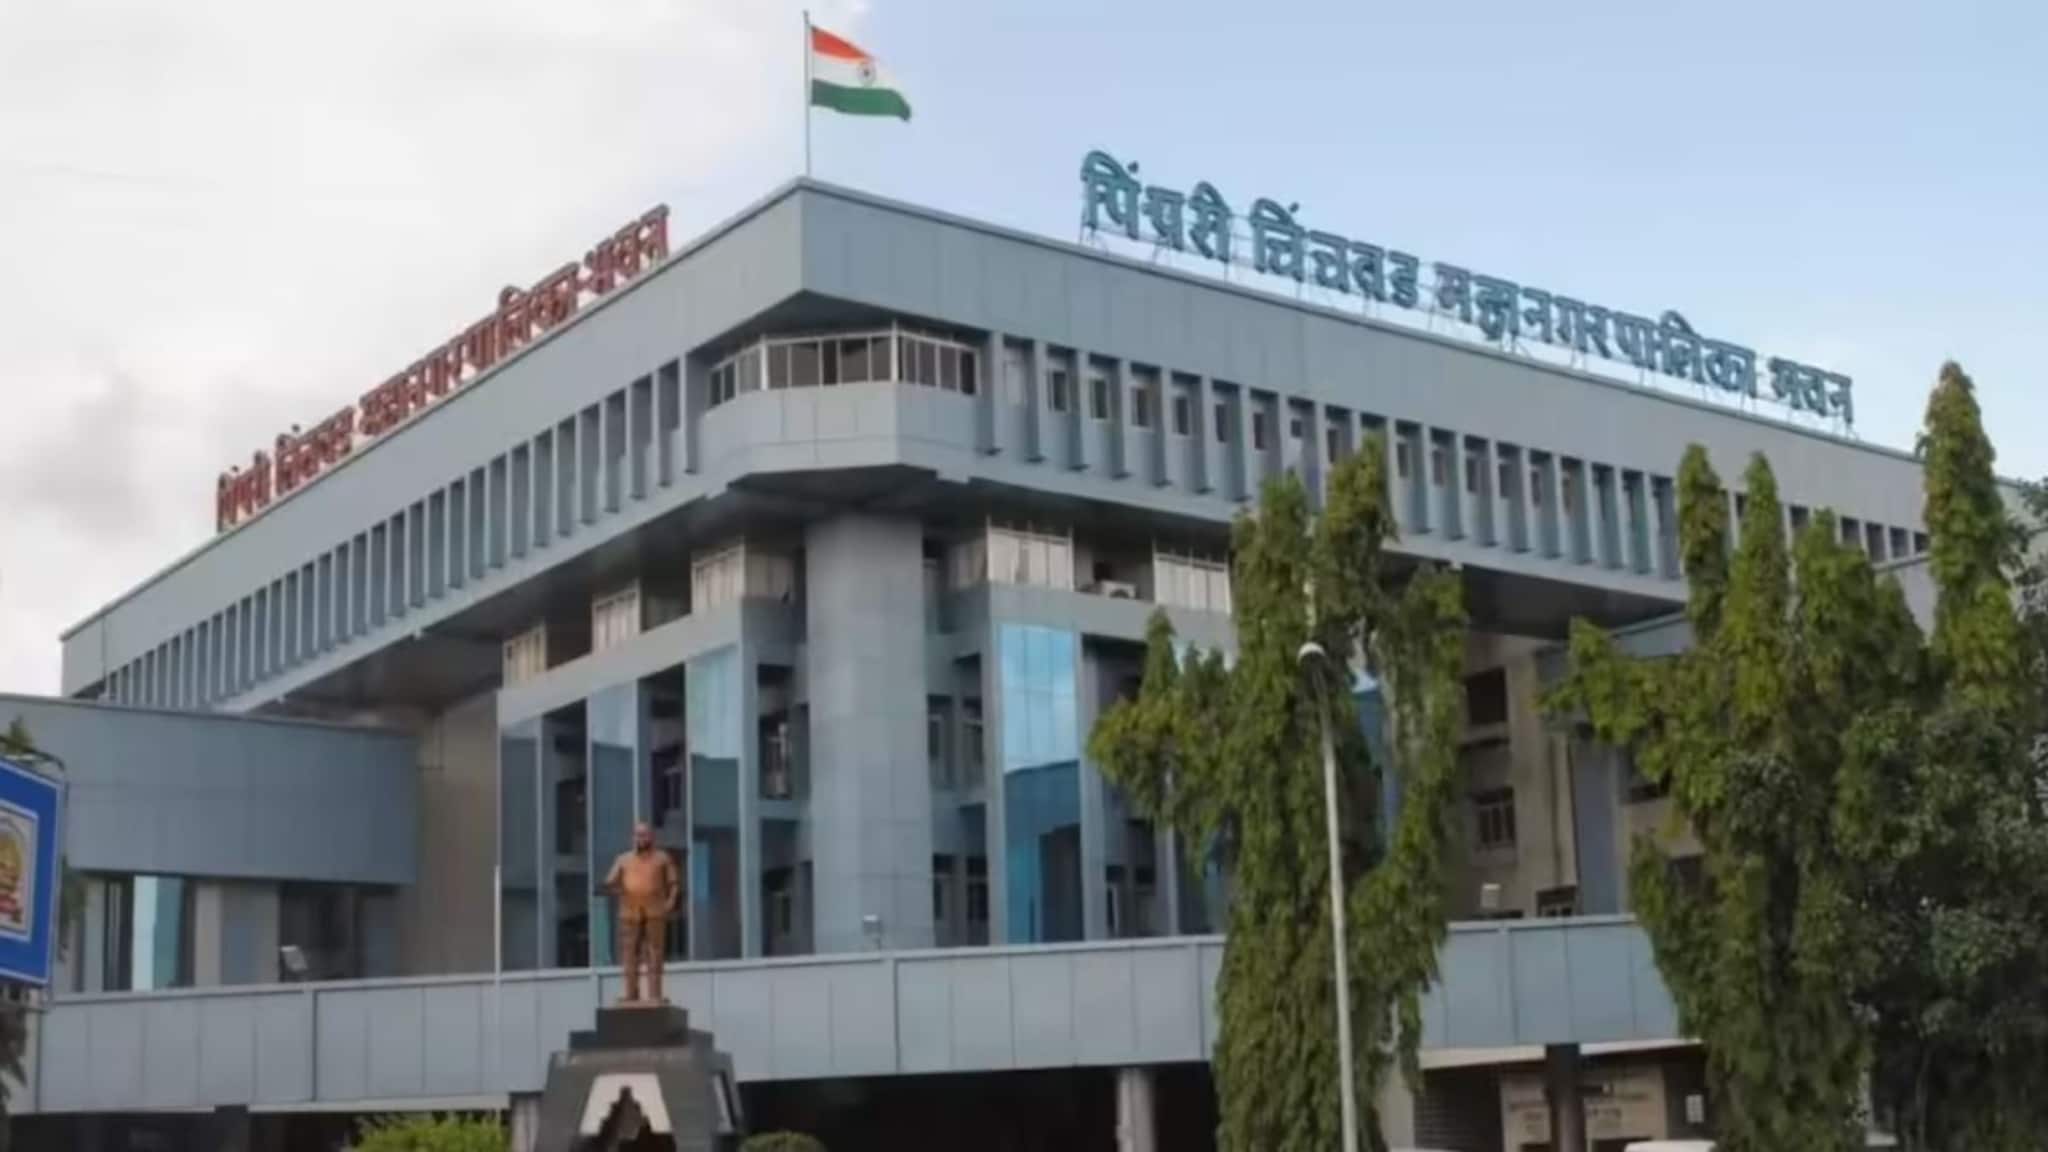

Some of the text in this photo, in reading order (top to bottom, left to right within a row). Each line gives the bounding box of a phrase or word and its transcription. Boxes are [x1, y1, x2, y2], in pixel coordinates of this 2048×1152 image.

[1081, 150, 1853, 424] पिंपरी चिंचवड महानगरपालिका भवन
